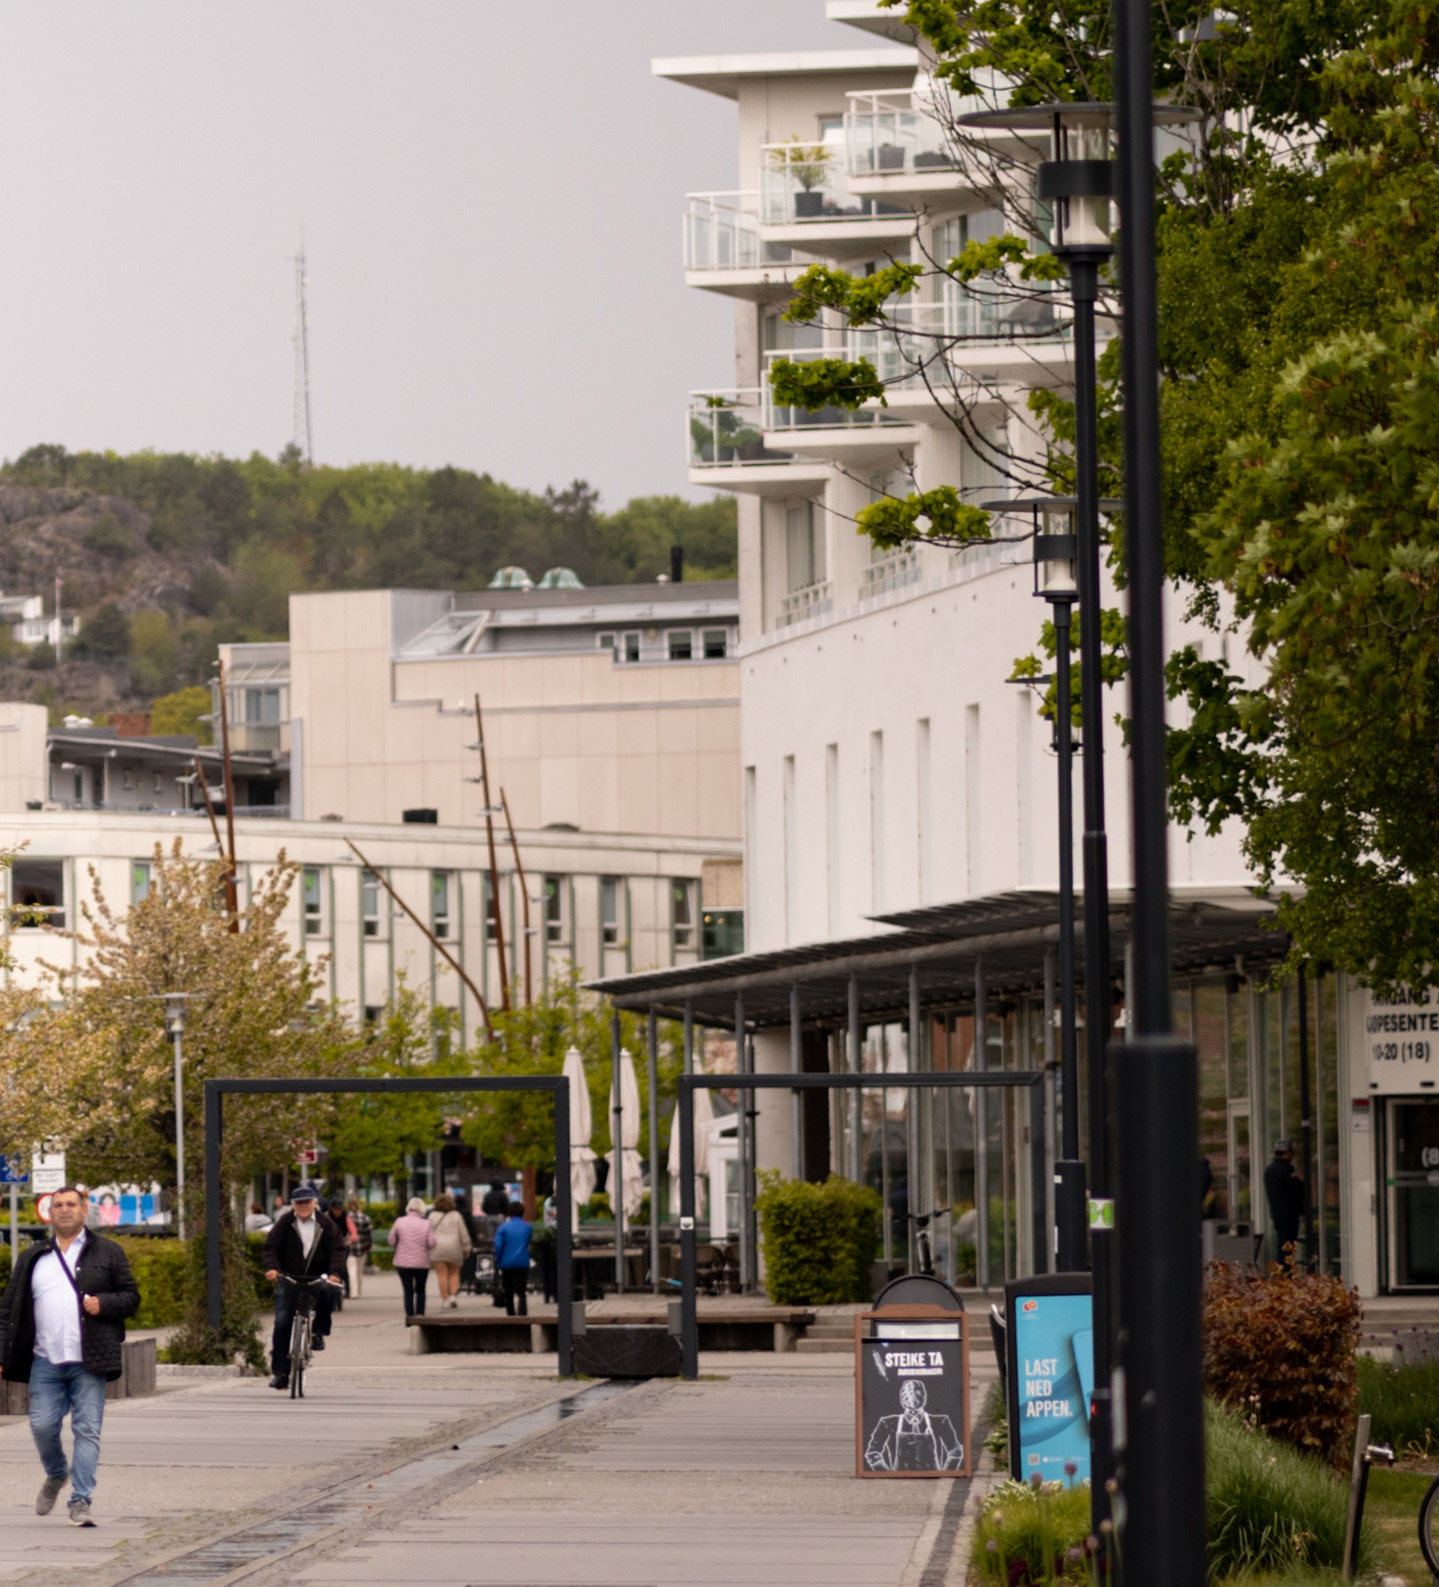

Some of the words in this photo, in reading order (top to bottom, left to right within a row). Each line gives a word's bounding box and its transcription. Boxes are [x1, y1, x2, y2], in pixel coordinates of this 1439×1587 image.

[1372, 1042, 1398, 1060] 10-20
[1402, 1041, 1430, 1064] (18)
[885, 1352, 926, 1367] STEIKE
[928, 1351, 944, 1366] TA
[1025, 1358, 1058, 1376] LAST
[1026, 1379, 1052, 1397] NED
[1026, 1400, 1073, 1418] APPEN.
